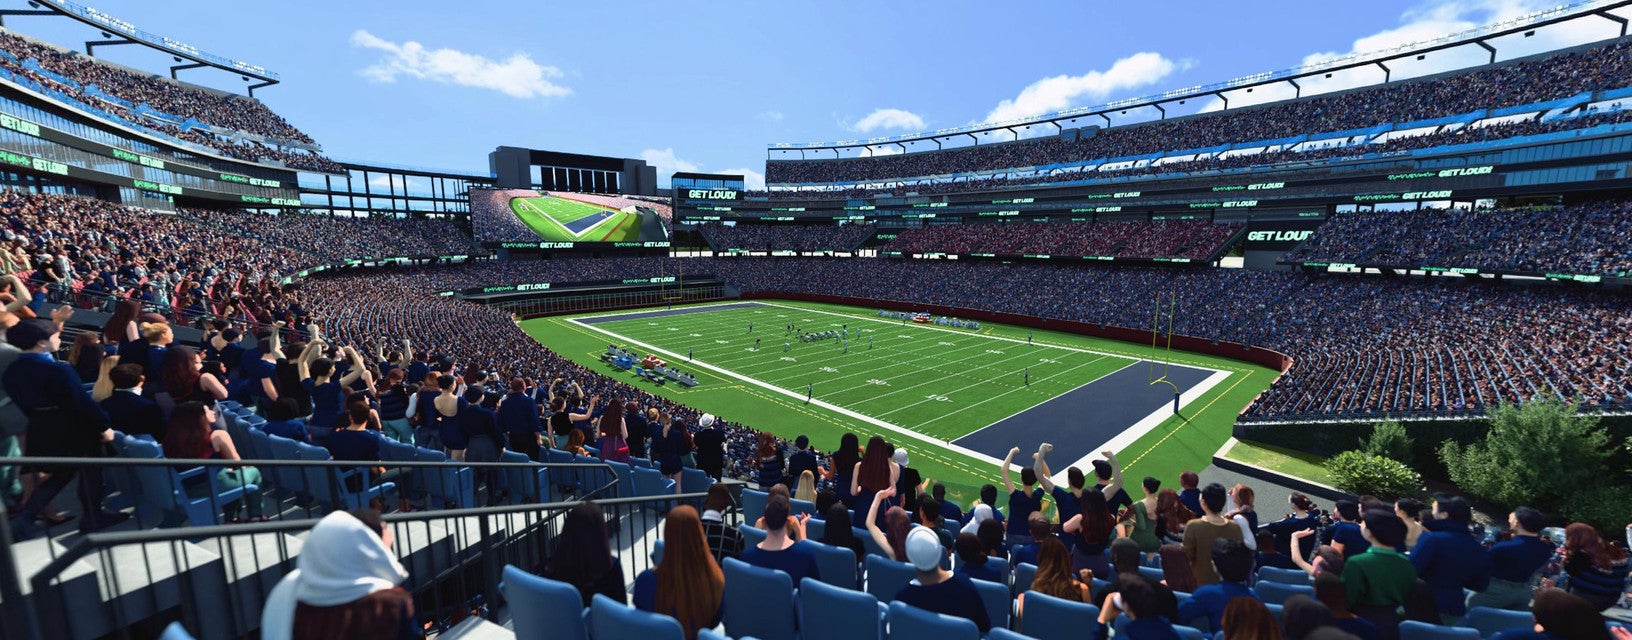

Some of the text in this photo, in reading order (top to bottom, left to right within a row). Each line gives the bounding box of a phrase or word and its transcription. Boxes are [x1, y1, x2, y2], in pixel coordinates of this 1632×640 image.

[1439, 166, 1493, 177] GET LOUD!
[689, 190, 736, 199] GET LOUD!
[1422, 190, 1452, 198] LOUD!
[1248, 231, 1275, 241] GET
